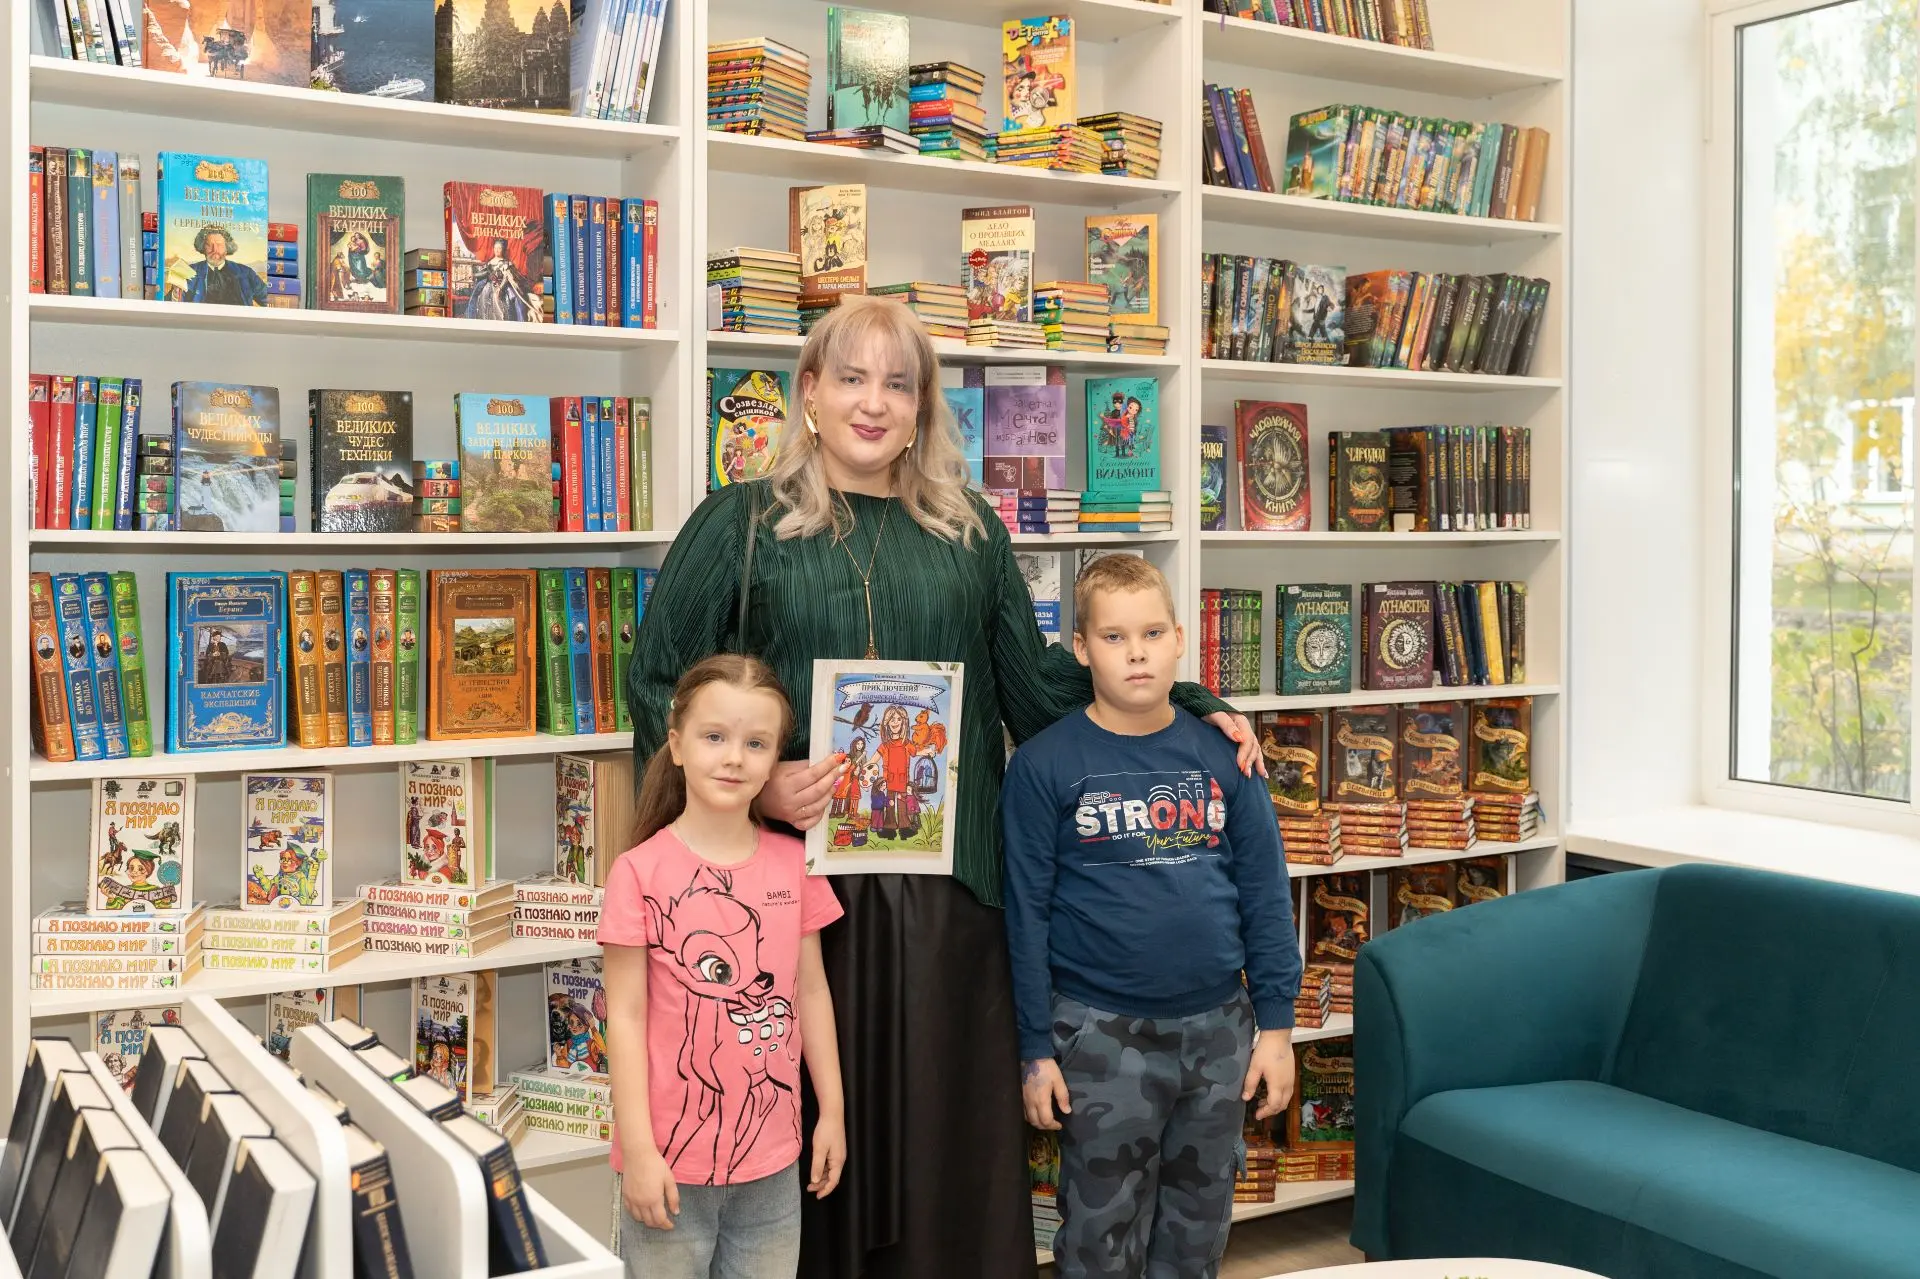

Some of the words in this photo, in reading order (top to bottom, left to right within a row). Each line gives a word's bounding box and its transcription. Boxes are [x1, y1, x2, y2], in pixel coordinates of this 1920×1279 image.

[184, 186, 250, 205] ВЕЛИКИХ
[350, 188, 366, 197] 100
[490, 195, 507, 204] 100
[201, 205, 233, 219] ИМЕН
[329, 205, 388, 220] ВЕЛИКИХ
[333, 219, 384, 234] КАРТИН
[471, 212, 527, 228] ВЕЛИКИХ
[473, 226, 525, 241] ДИНАСТИЙ
[223, 394, 241, 405] 100
[357, 402, 374, 411] 100
[720, 396, 779, 414] Созвездие
[497, 405, 514, 414] 100
[200, 412, 262, 428] ВЕЛИКИХ
[336, 420, 396, 434] ВЕЛИКИХ
[188, 427, 223, 442] ЧУДЕС
[223, 430, 272, 444] ПРИРОДЫ
[476, 422, 537, 436] ВЕЛИКИХ
[348, 435, 384, 449] ЧУДЕС
[467, 437, 547, 449] ЗАПОВЕДНИКОВ
[340, 449, 392, 462] ТЕХНИКИ
[483, 450, 491, 460] И
[493, 450, 533, 460] ПАРКОВ
[1096, 467, 1156, 480] ВИЛЬМОНТ
[1264, 499, 1297, 513] КНИГА
[1294, 601, 1350, 616] ЛУНАСТРЫ
[1378, 599, 1430, 614] ЛУНАСТРЫ
[201, 688, 261, 699] КАМЧАТСКИЕ
[862, 684, 919, 692] ПРИКЛЮЧЕНИЯ
[204, 699, 257, 709] ЭКСПЕДИЦИИ
[408, 781, 417, 794] Я
[419, 783, 463, 797] ПОЗНАЮ
[566, 788, 580, 801] МИР
[105, 800, 116, 815] Я
[120, 800, 179, 815] ПОЗНАЮ
[255, 797, 265, 810] Я
[268, 798, 318, 811] ПОЗНАЮ
[423, 795, 448, 808] МИР
[125, 815, 157, 829] МИР
[271, 812, 297, 824] МИР
[1075, 799, 1226, 836] STRONG
[368, 888, 376, 900] Я
[379, 889, 423, 904] ПОЗНАЮ
[426, 893, 450, 906] МИР
[516, 889, 525, 901] Я
[527, 891, 569, 903] ПОЗНАЮ
[572, 893, 594, 905] МИР
[766, 890, 792, 900] BAMBI
[366, 902, 375, 914] Я
[377, 904, 417, 919] ПОЗНАЮ
[419, 908, 441, 922] МИР
[513, 906, 521, 919] Я
[525, 908, 571, 921] ПОЗНАЮ
[575, 910, 599, 923] МИР
[49, 920, 59, 932] Я
[62, 920, 118, 932] ПОЗНАЮ
[121, 921, 151, 932] МИР
[212, 915, 221, 928] Я
[224, 916, 272, 931] ПОЗНАЮ
[274, 918, 300, 932] МИР
[372, 921, 418, 935] ПОЗНАЮ
[420, 925, 444, 937] МИР
[515, 924, 523, 936] Я
[526, 926, 575, 939] ПОЗНАЮ
[578, 928, 597, 940] МИ
[47, 938, 57, 951] Я
[60, 938, 116, 951] ПОЗНАЮ
[119, 939, 148, 952] МИР
[211, 935, 220, 948] Я
[222, 936, 268, 949] ПОЗНАЮ
[271, 938, 297, 951] МИР
[364, 937, 373, 950] Я
[375, 939, 422, 952] ПОЗНАЮ
[426, 942, 450, 955] МИР
[48, 959, 59, 972] Я
[62, 959, 122, 973] ПОЗНАЮ
[126, 959, 158, 972] МИР
[210, 955, 220, 968] Я
[222, 956, 268, 969] ПОЗНАЮ
[271, 957, 296, 970] МИР
[43, 974, 53, 988] Я
[57, 974, 114, 988] ПОЗНАЮ
[118, 975, 149, 988] МИР
[552, 972, 560, 984] Я
[562, 974, 601, 989] ПОЗНАЮ
[568, 988, 588, 1000] МИР
[273, 1004, 281, 1017] Я
[422, 994, 428, 1006] Я
[430, 997, 464, 1013] ПОЗНАЮ
[433, 1010, 451, 1022] МИР
[101, 1029, 111, 1045] Я
[120, 1043, 143, 1056] МИ
[566, 1104, 589, 1117] МИР
[567, 1121, 589, 1135] МИР
